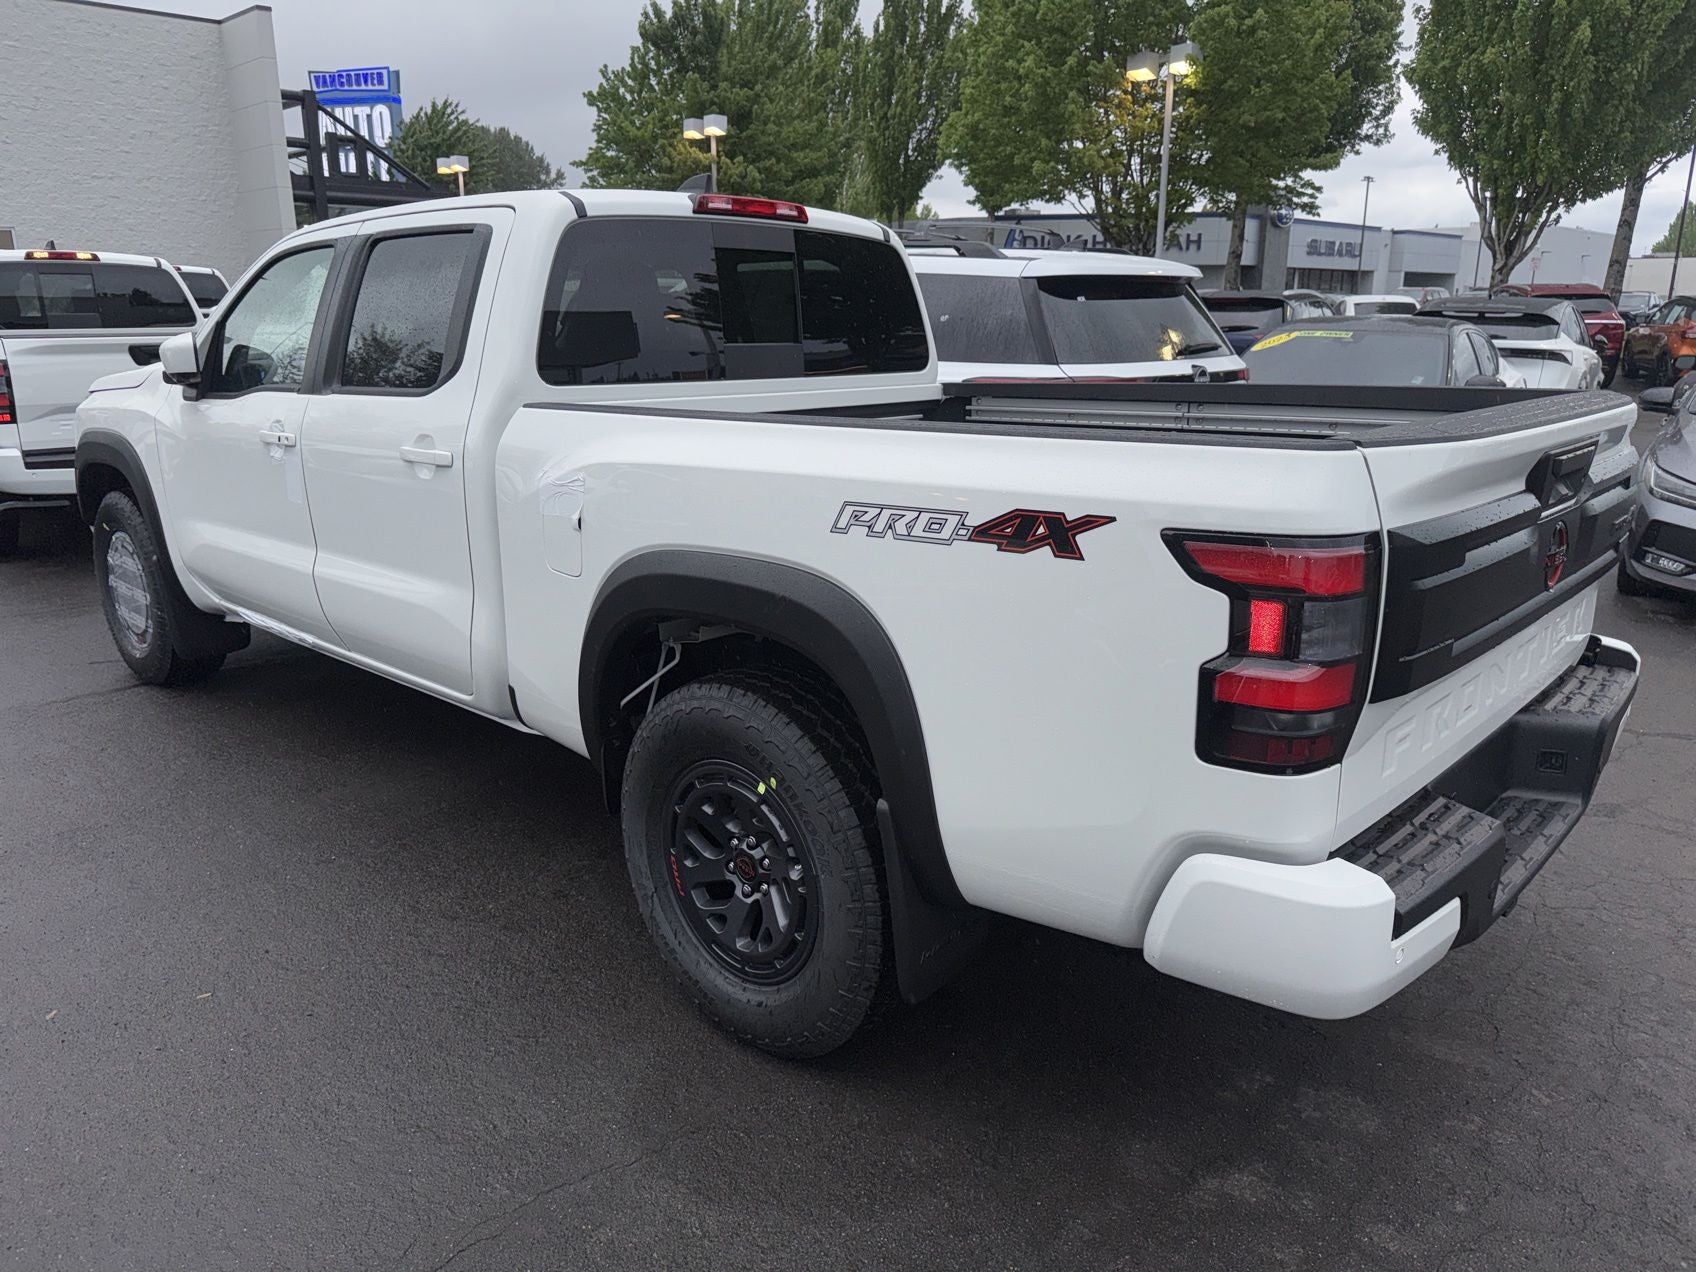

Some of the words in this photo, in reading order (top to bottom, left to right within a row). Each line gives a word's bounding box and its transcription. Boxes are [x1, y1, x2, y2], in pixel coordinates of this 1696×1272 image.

[313, 72, 385, 89] VANCOUVER
[317, 104, 392, 149] AUTO
[1023, 234, 1083, 249] DIK
[1306, 239, 1361, 258] SUBARU
[1381, 596, 1590, 778] FRONTIER
